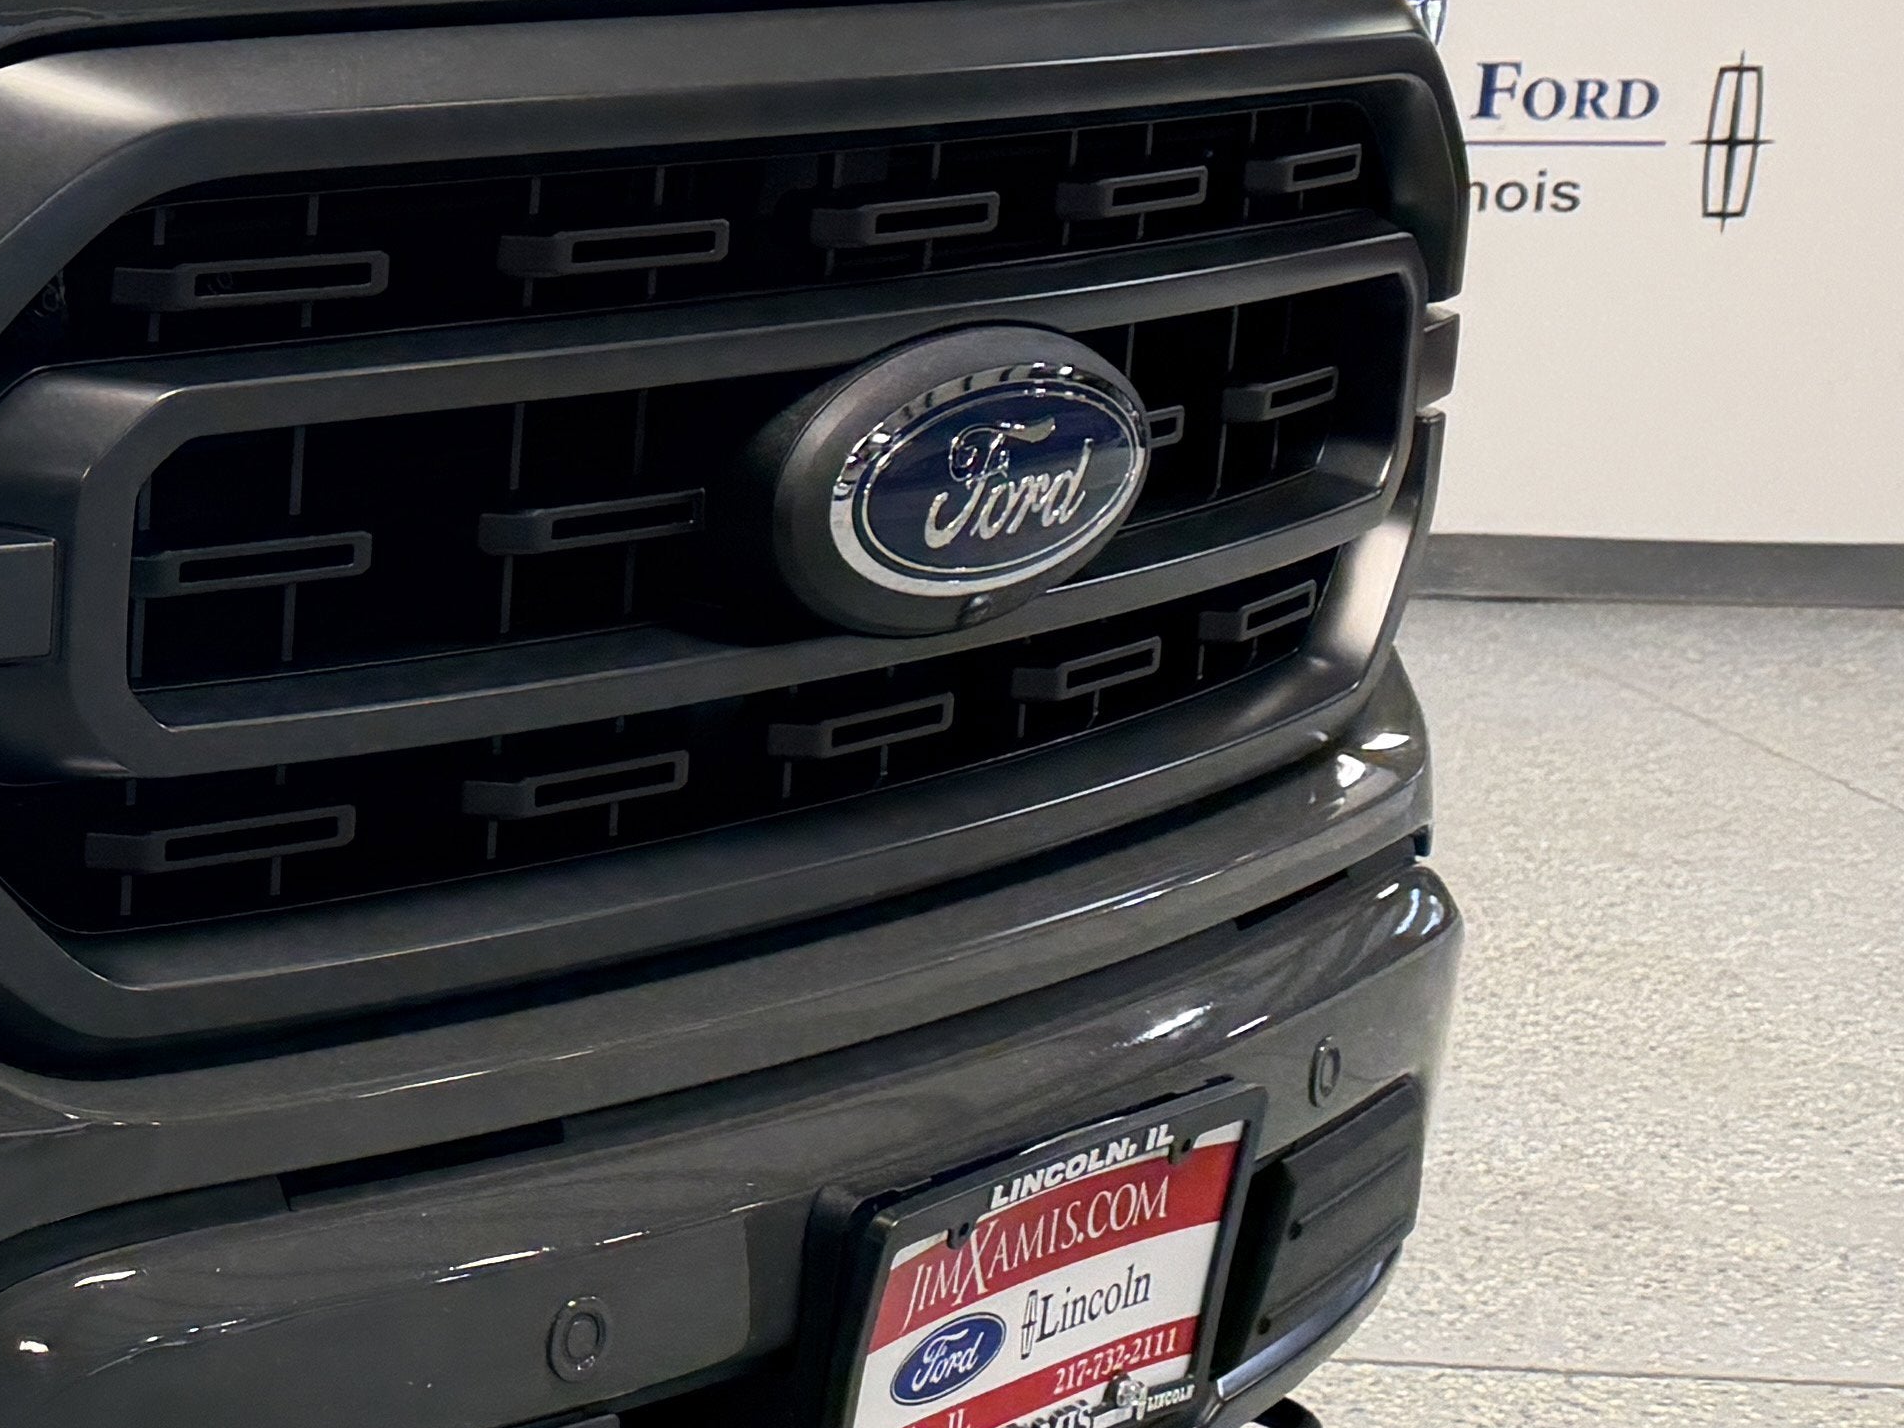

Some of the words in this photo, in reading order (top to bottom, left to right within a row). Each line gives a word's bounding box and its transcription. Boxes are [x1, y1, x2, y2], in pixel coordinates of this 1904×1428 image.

[1469, 61, 1661, 122] FORD
[1466, 168, 1583, 214] nois
[924, 416, 1093, 549] Ford
[990, 1136, 1138, 1210] LINCOLN,
[1144, 1123, 1175, 1153] IL
[903, 1175, 1169, 1335] JIMXAMIS.COM
[1035, 1263, 1152, 1344] Lincoln
[911, 1327, 980, 1393] Ford
